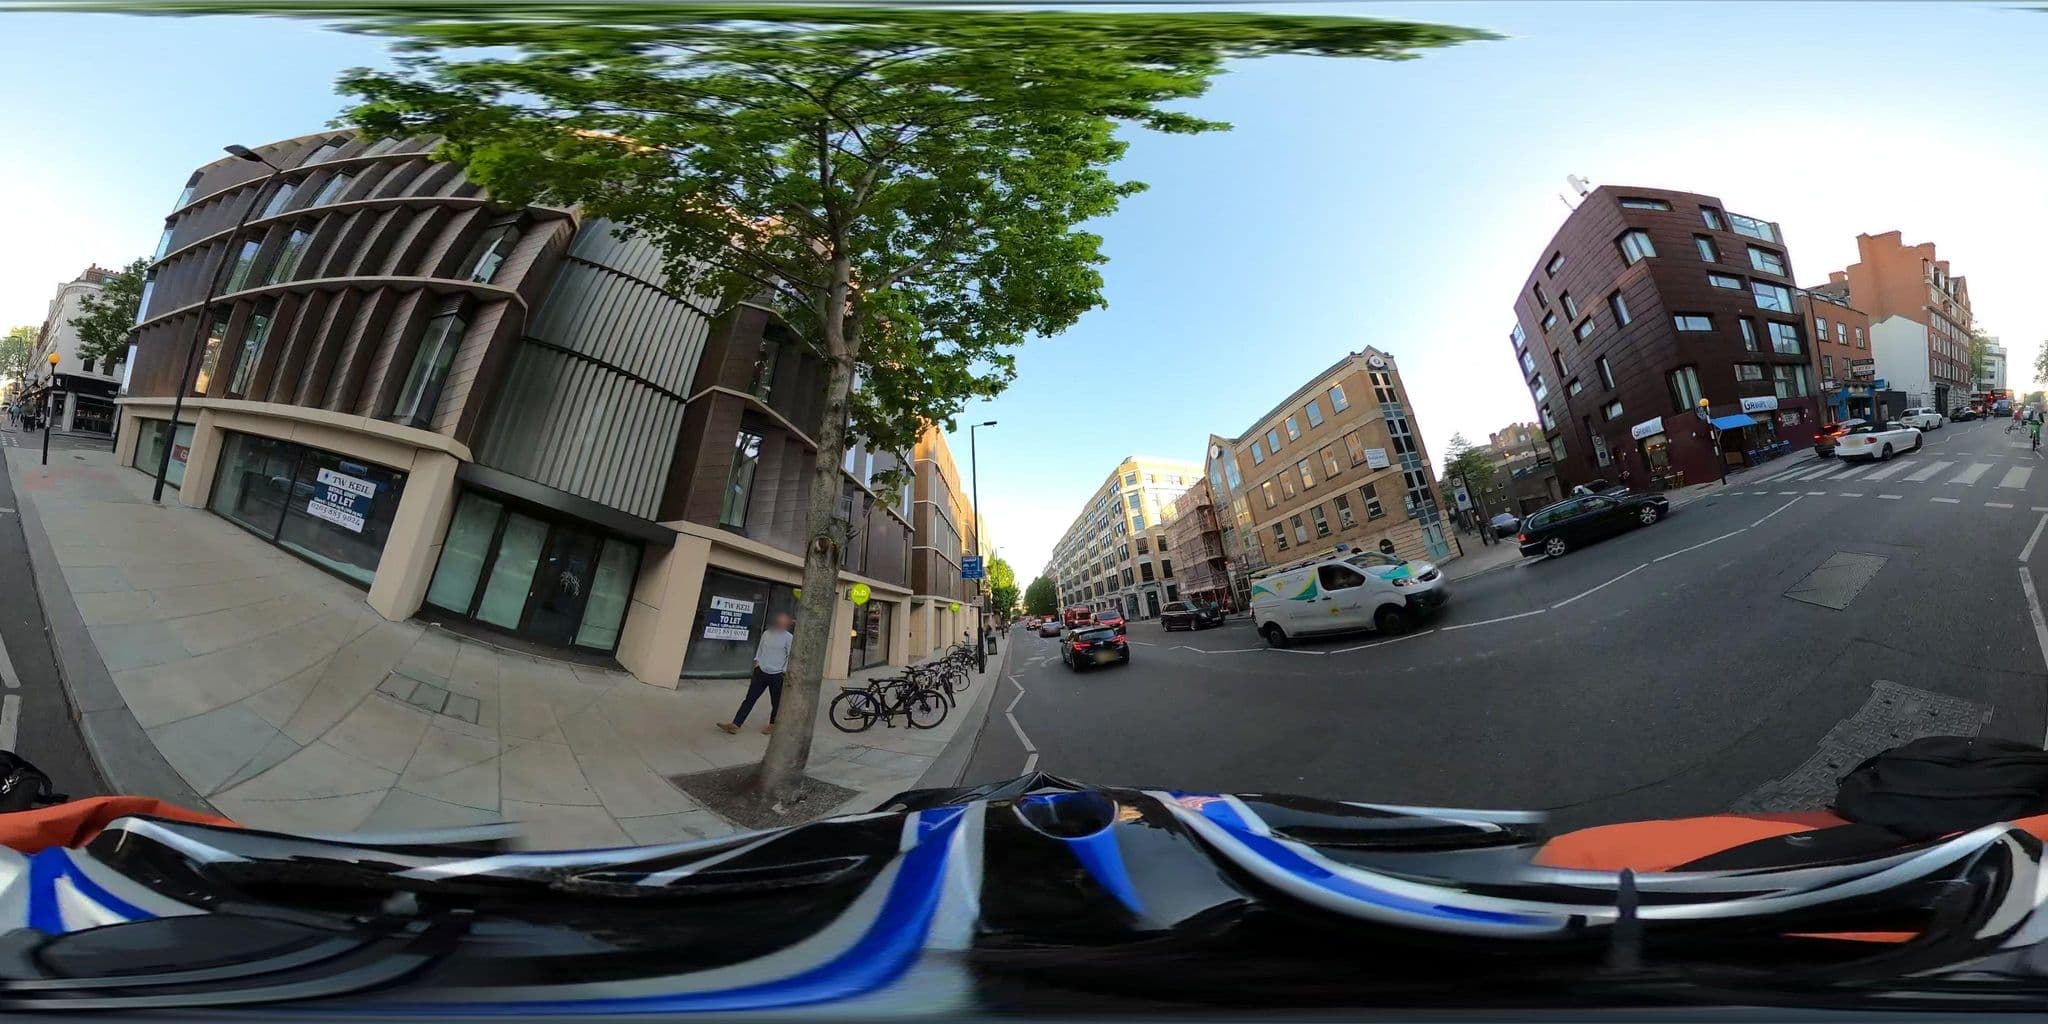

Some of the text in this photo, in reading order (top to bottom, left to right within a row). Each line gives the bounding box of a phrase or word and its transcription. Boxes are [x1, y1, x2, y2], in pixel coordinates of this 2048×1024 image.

[327, 492, 338, 502] TO
[338, 496, 355, 508] LET
[720, 615, 729, 623] TO
